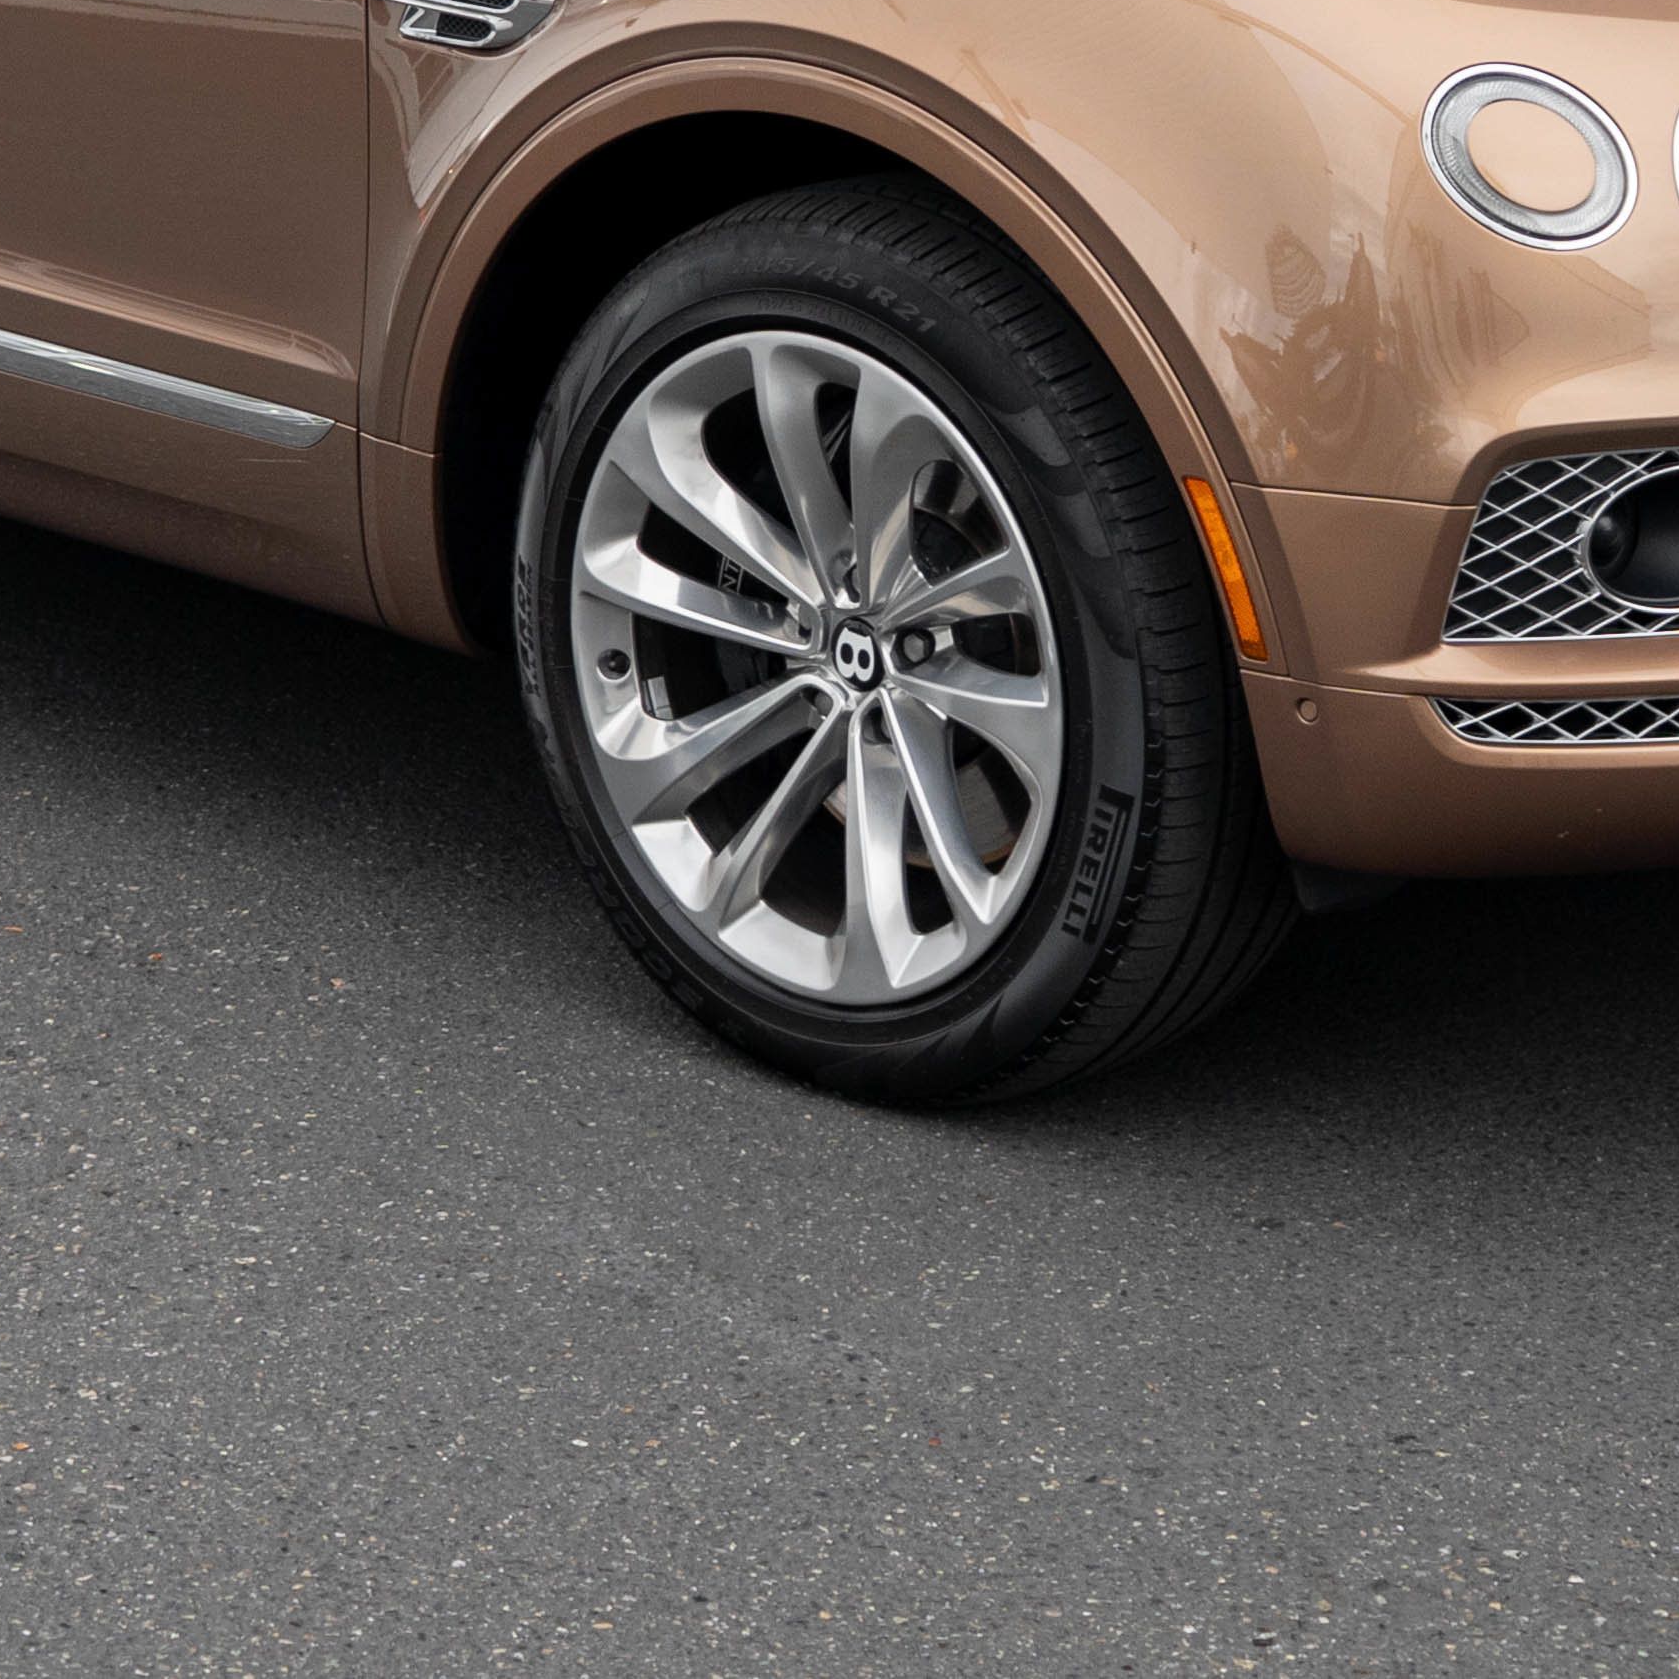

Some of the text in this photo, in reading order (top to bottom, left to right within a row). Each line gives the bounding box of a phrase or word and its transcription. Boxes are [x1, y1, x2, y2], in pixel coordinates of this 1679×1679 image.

[868, 286, 937, 332] R21
[834, 627, 875, 681] B
[1061, 784, 1135, 945] PIRELLI
